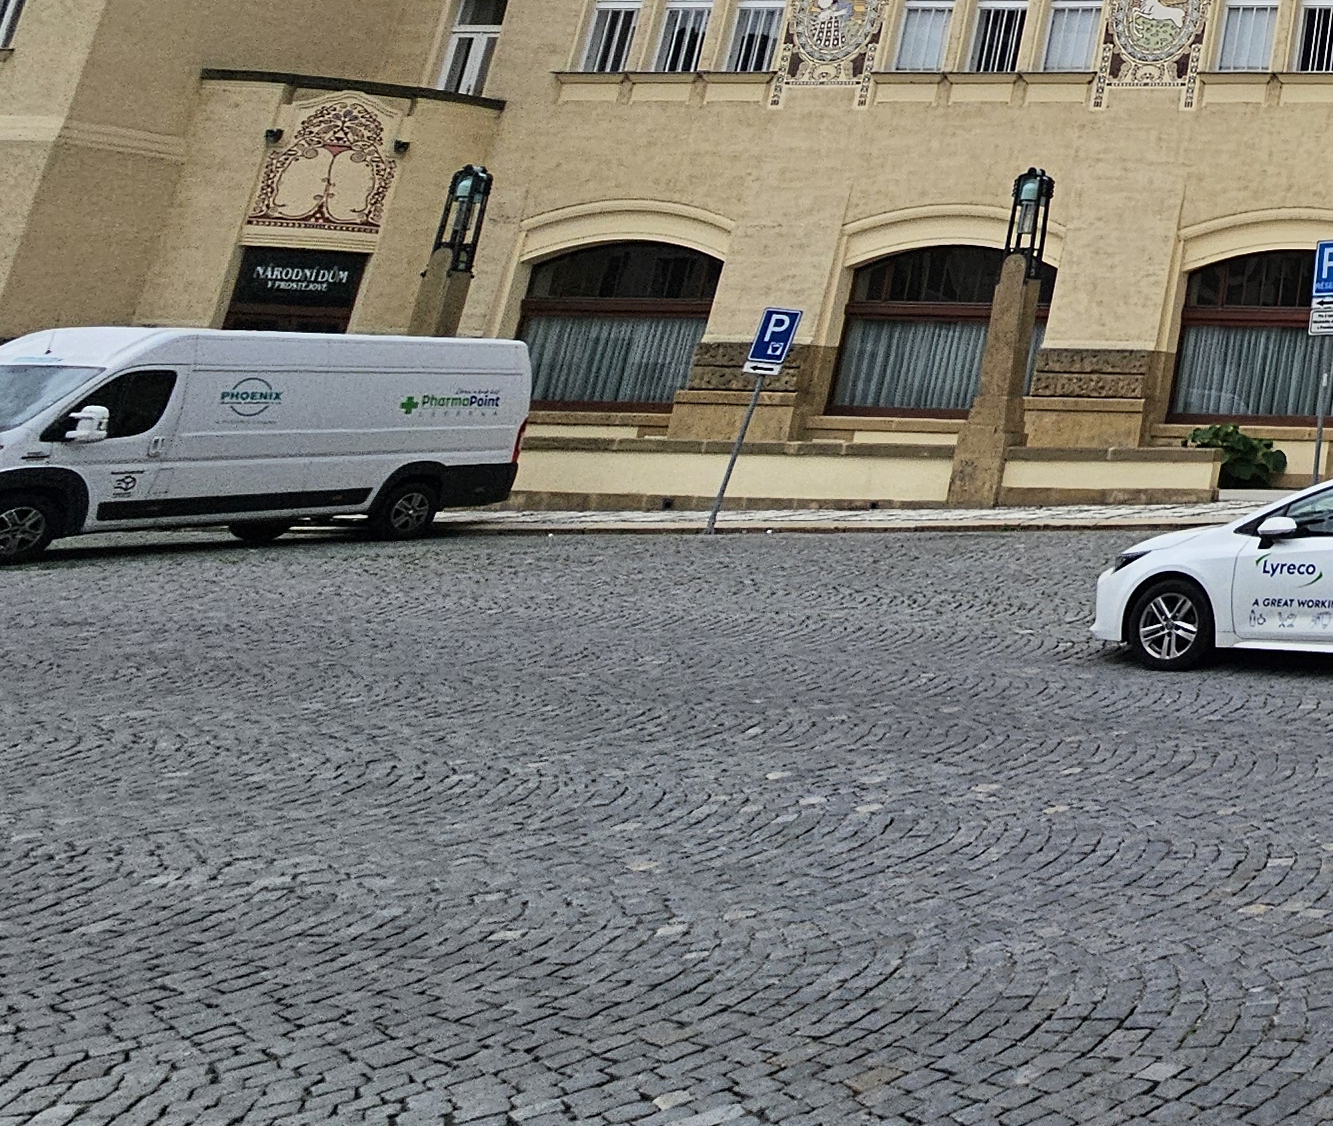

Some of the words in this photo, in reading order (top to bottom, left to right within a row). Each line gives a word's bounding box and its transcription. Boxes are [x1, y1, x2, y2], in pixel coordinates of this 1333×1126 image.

[253, 263, 319, 282] NÁRODNÍ
[318, 265, 349, 284] DŮM
[763, 314, 790, 342] P
[220, 391, 283, 401] PHOENIX
[421, 394, 500, 407] PharmaPoint
[1262, 559, 1317, 577] Lyreco
[1252, 598, 1259, 607] A
[1263, 598, 1294, 608] GREAT
